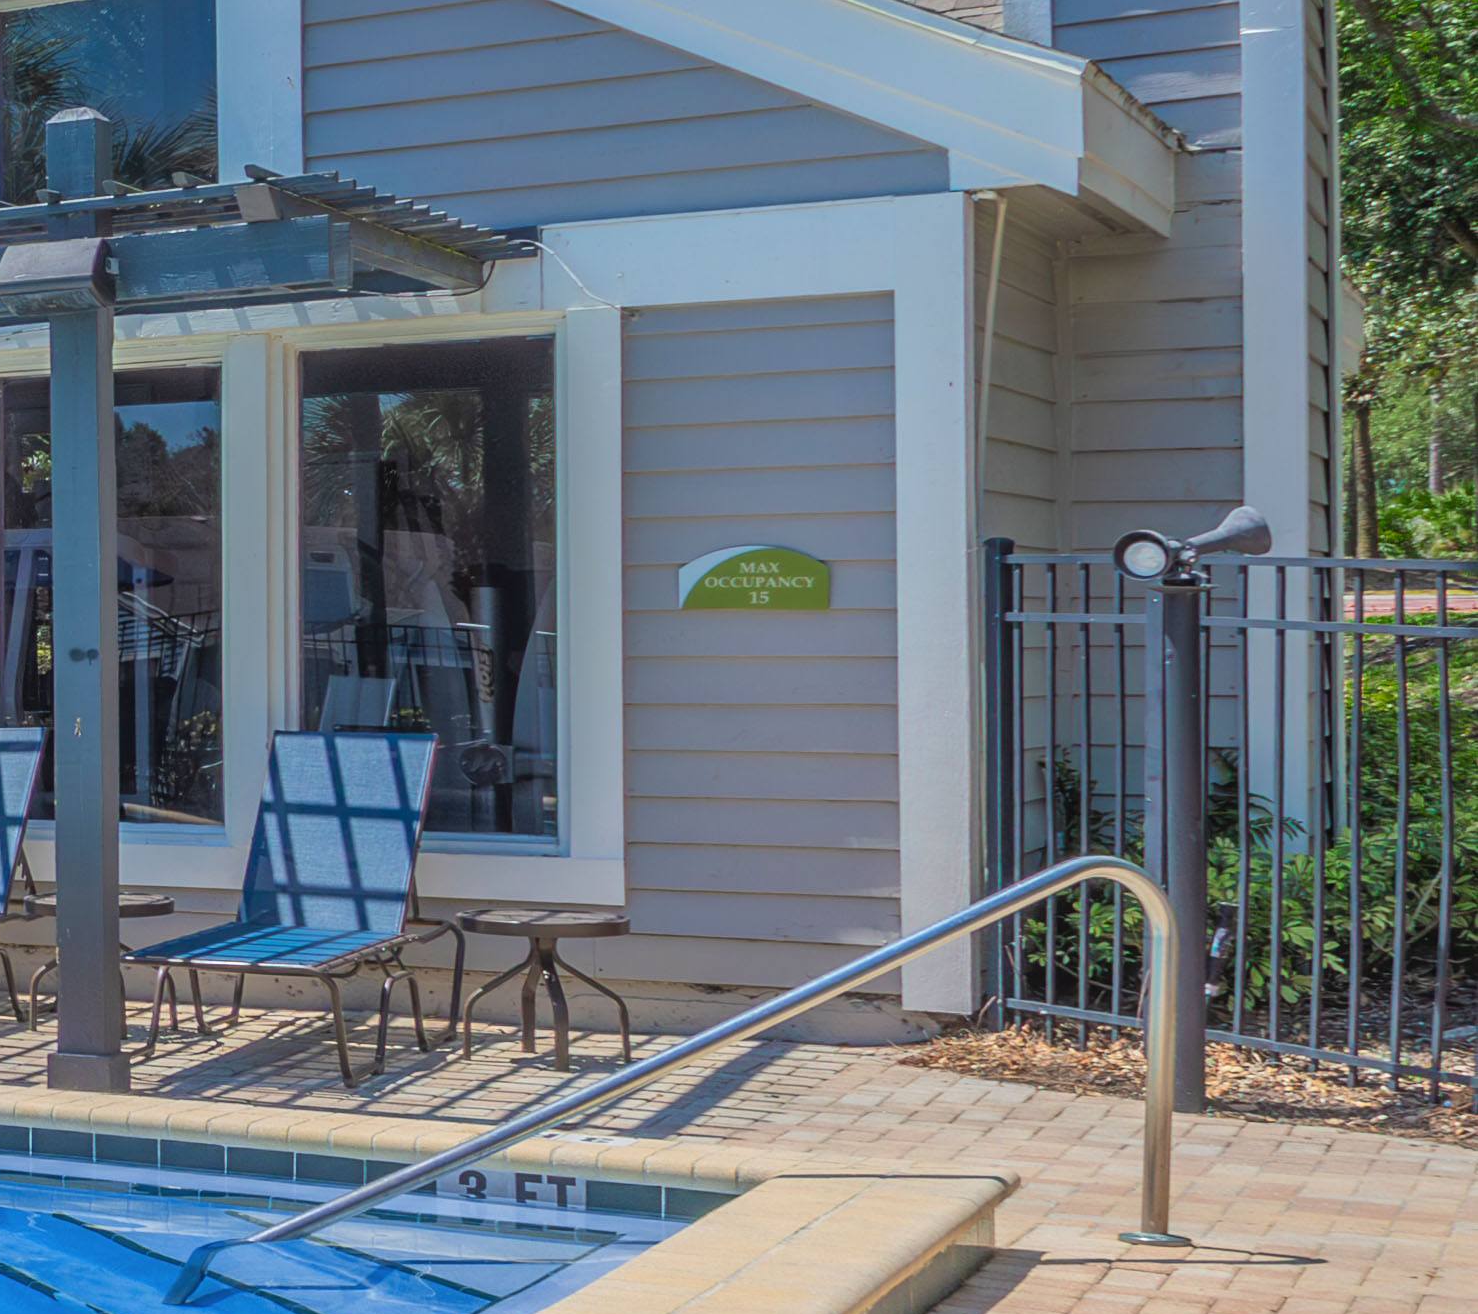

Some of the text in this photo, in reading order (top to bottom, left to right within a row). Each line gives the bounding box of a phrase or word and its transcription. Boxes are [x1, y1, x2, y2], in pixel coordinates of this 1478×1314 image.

[739, 562, 780, 574] MAX
[704, 576, 815, 588] OCCUPANCY
[750, 591, 770, 604] 15
